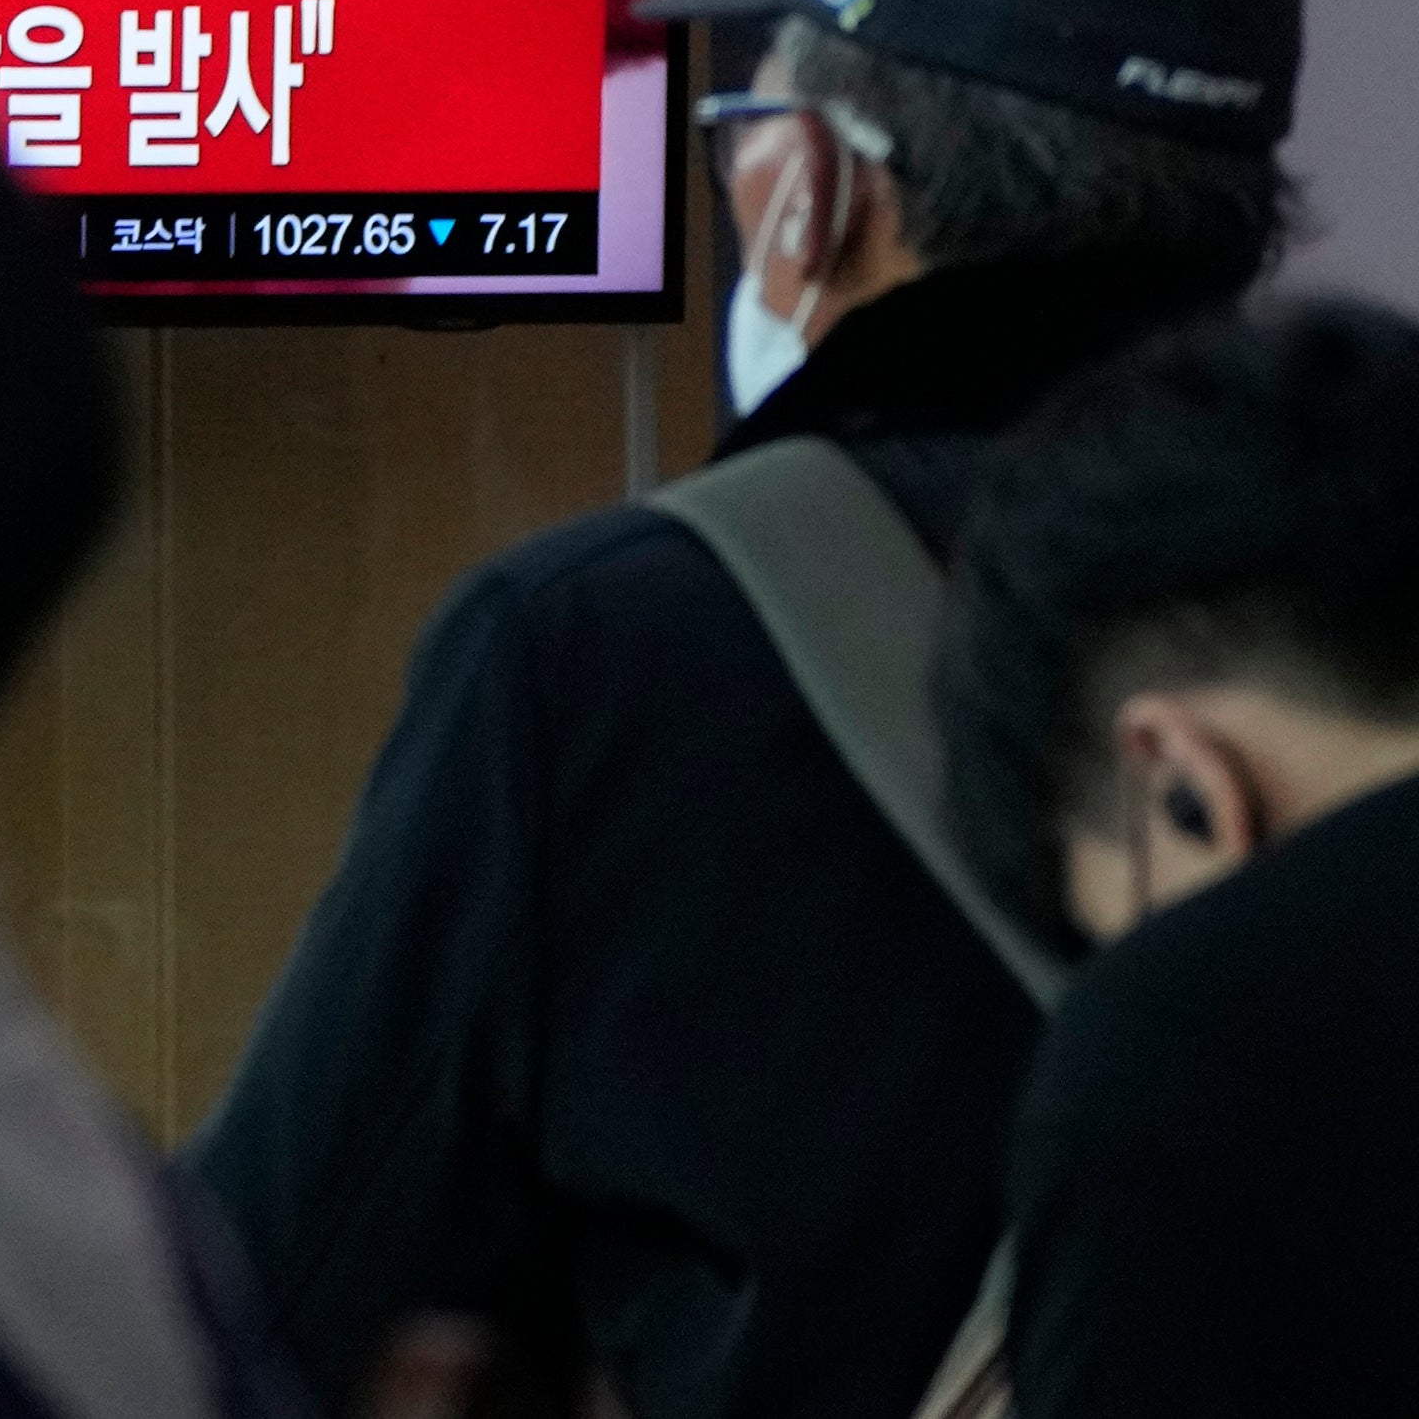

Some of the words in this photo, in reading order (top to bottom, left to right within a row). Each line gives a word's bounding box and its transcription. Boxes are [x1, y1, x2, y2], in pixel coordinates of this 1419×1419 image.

[111, 217, 206, 255] 코스닥
[253, 213, 416, 256] 1027.65
[479, 213, 569, 255] 7.17
